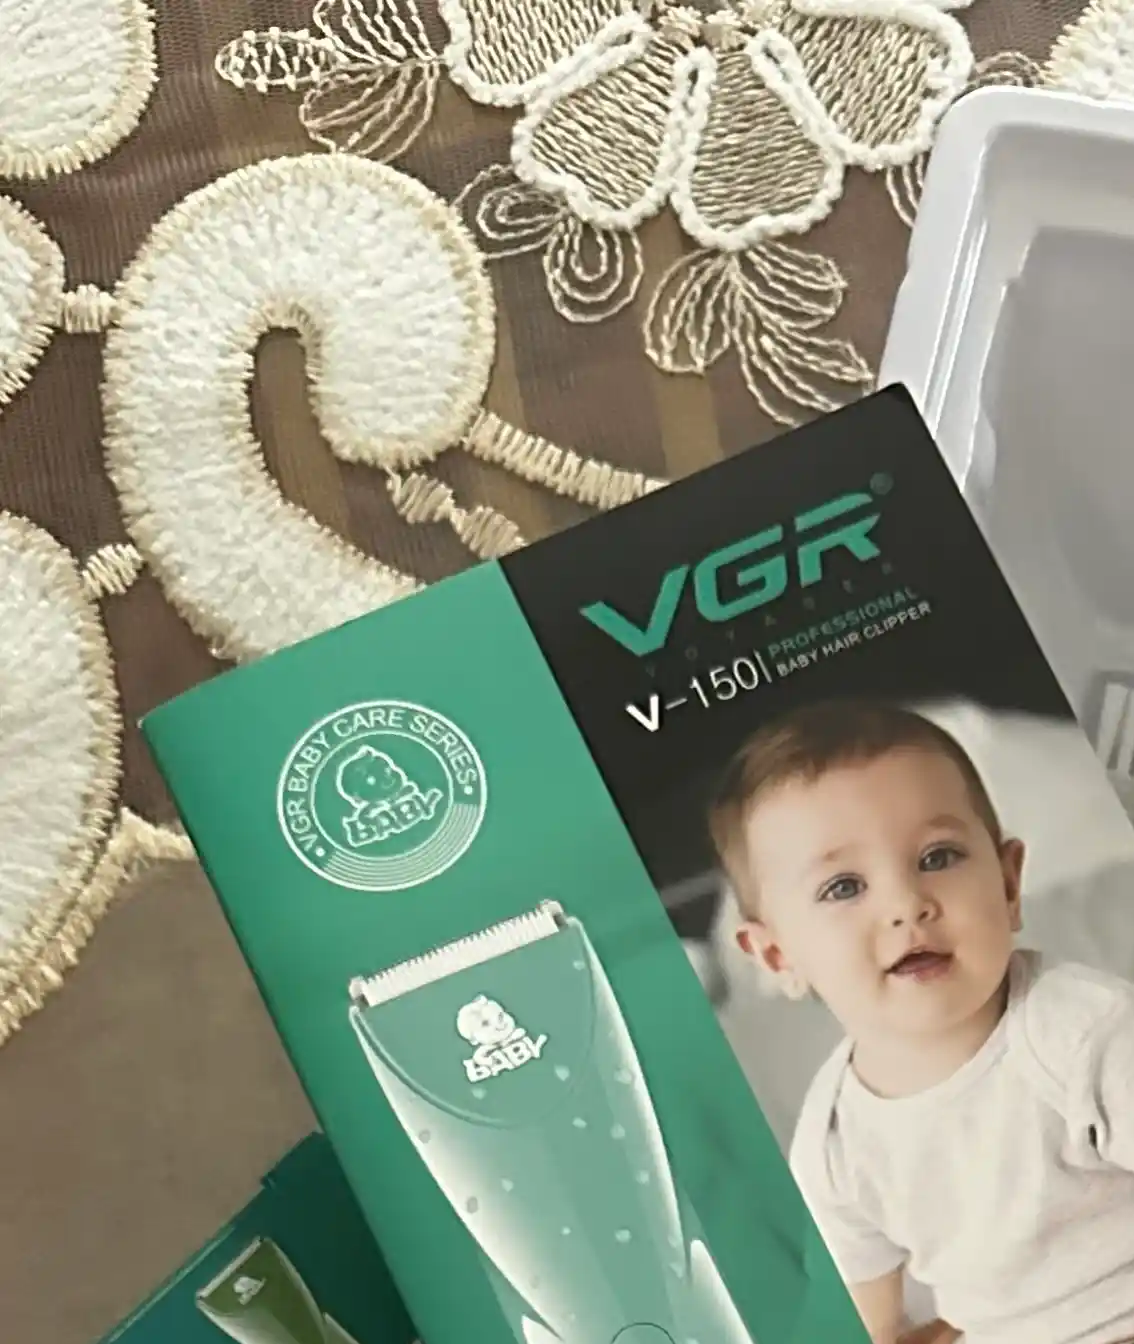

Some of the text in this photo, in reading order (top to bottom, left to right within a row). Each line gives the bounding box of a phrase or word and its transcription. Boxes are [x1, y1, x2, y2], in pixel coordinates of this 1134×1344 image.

[578, 492, 881, 657] VGR
[767, 586, 919, 658] PROFESSIONAL
[776, 601, 932, 677] BABY HAIR CLIPPER
[287, 708, 478, 851] VGR BABY CARE SERIES
[462, 1033, 548, 1083] BABY
